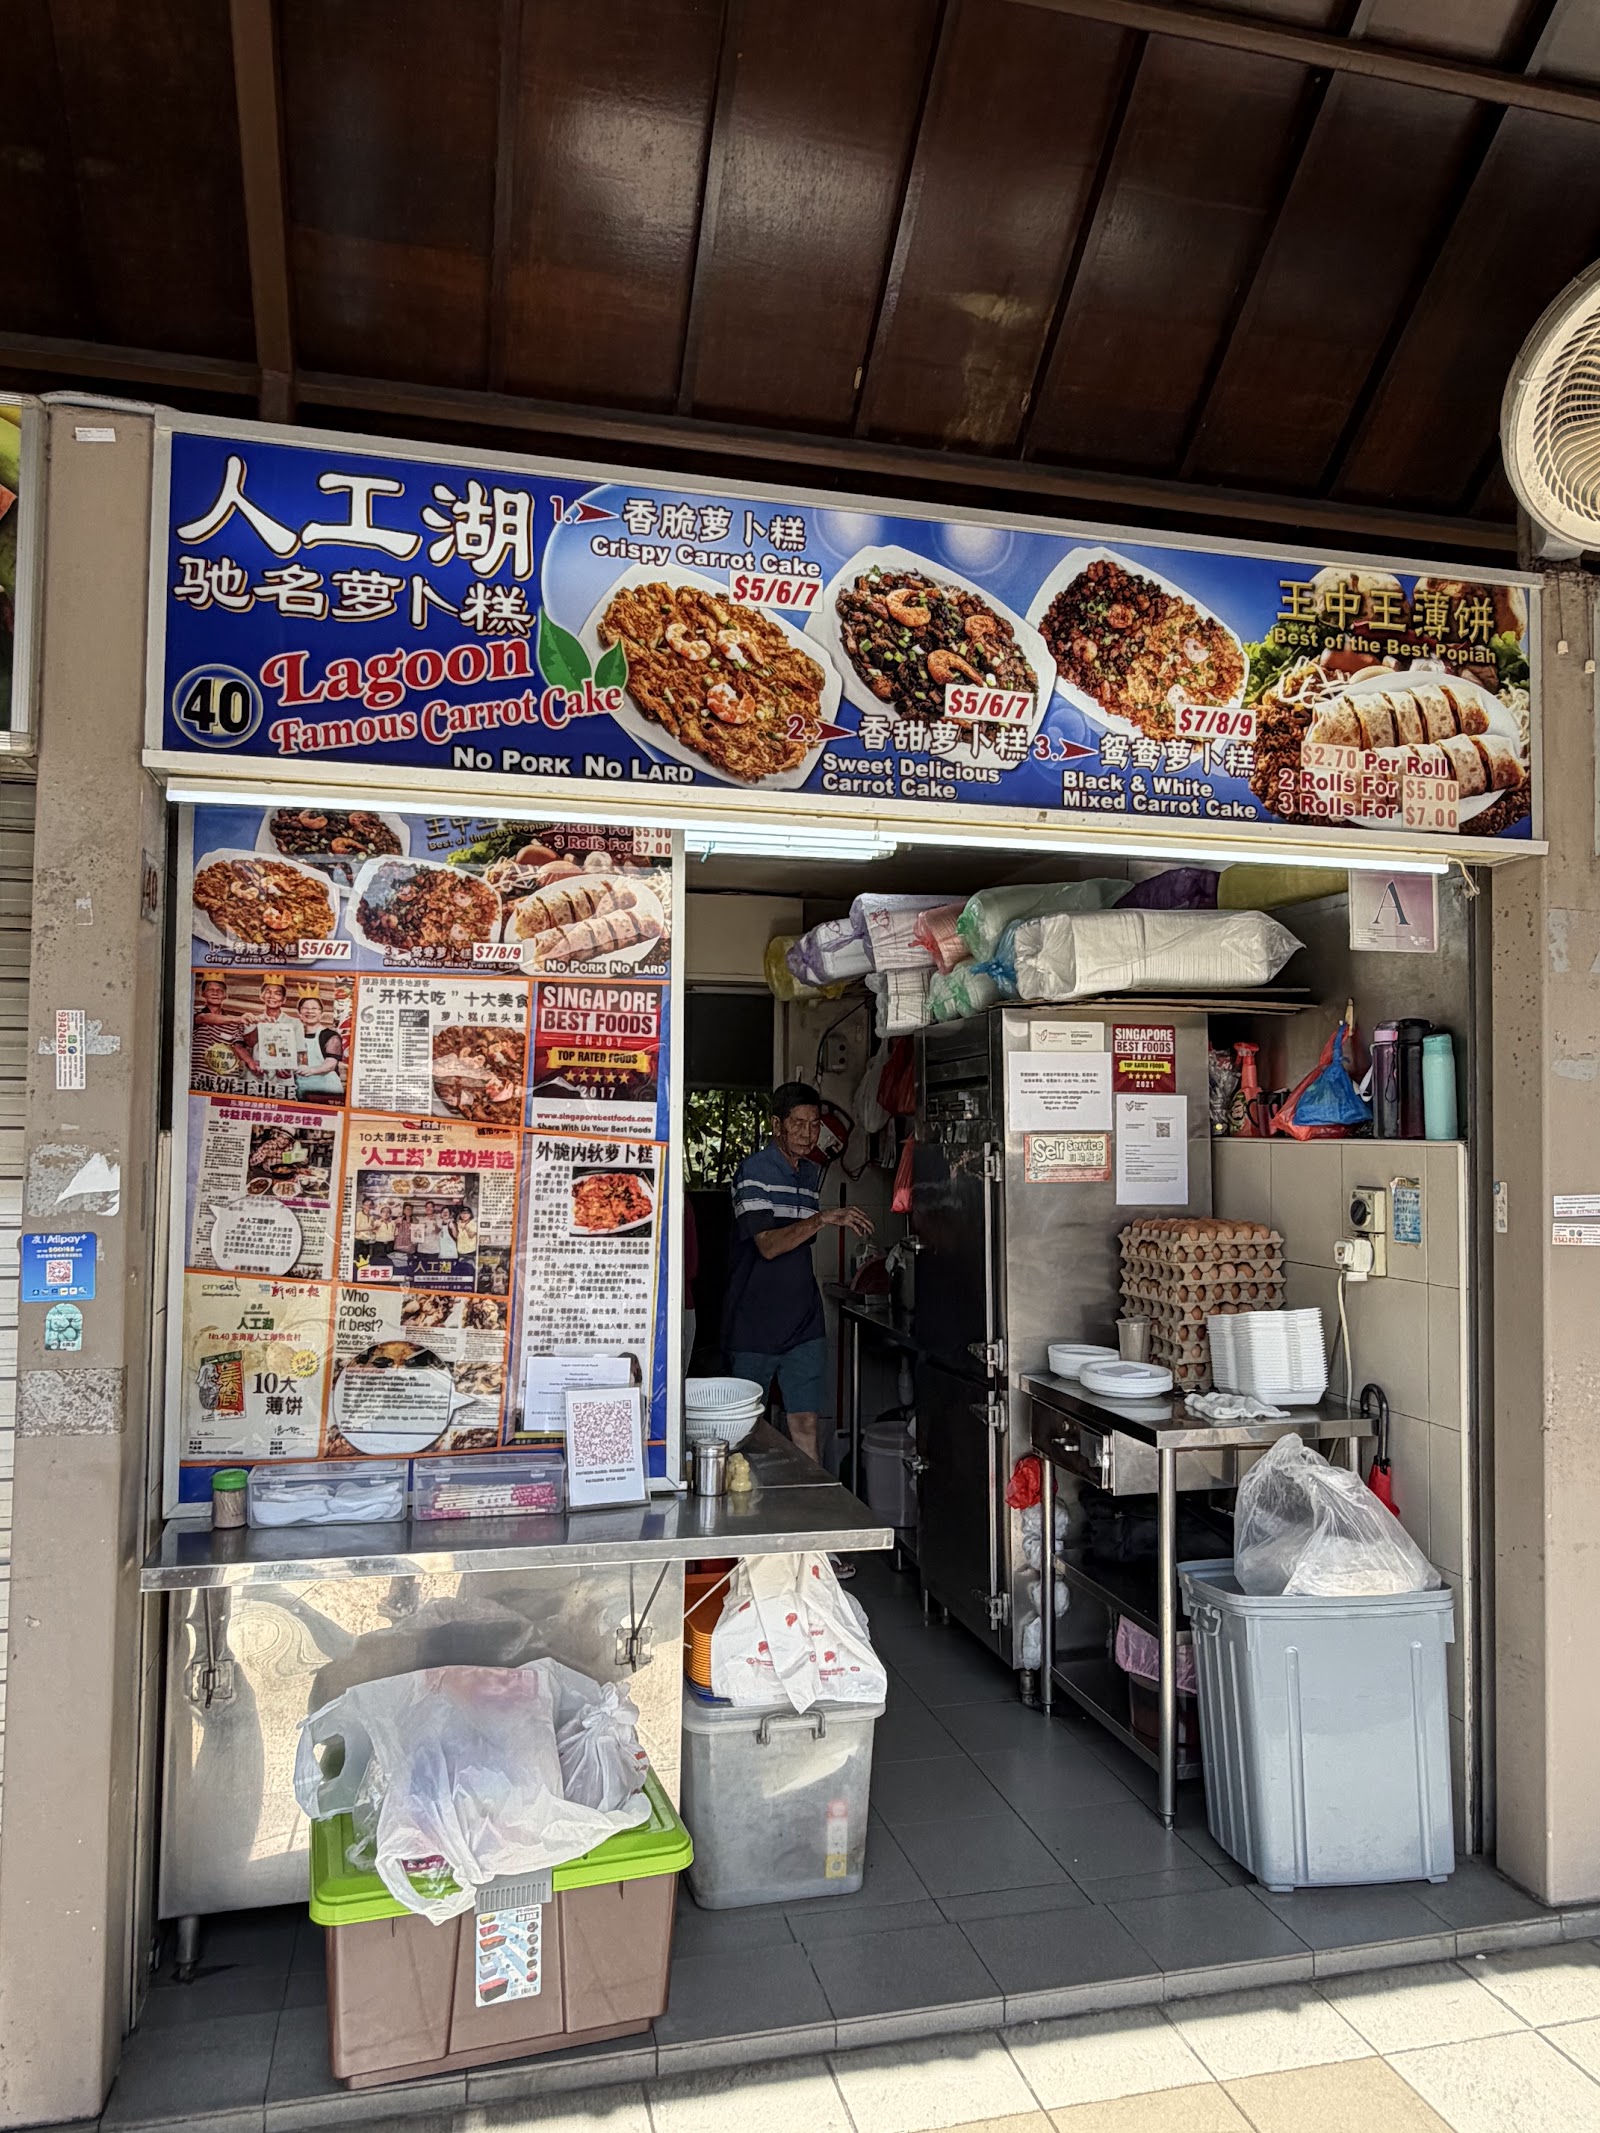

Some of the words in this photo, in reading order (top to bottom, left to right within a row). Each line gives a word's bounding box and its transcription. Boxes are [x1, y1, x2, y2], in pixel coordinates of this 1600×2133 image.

[177, 455, 534, 579] 人工湖
[550, 495, 572, 525] 1.
[623, 498, 807, 552] 香脆萝卜糕
[590, 536, 670, 566] Crispy
[676, 544, 755, 571] Carrot
[761, 554, 821, 577] Cake
[173, 556, 535, 638] 驰名萝卜糕
[733, 574, 820, 607] $5/6/7
[1277, 579, 1494, 644] 王中王薄饼
[1274, 627, 1318, 647] Best
[1324, 633, 1344, 650] of
[1351, 637, 1381, 654] the
[1387, 639, 1429, 658] Best
[1435, 644, 1497, 664] Popiah
[260, 637, 533, 710] Lagoon
[181, 678, 250, 735] 40
[948, 688, 1030, 720] $5/6/7
[268, 710, 416, 757] Famous
[421, 691, 539, 746] Carrot
[540, 678, 625, 731] Cake
[786, 715, 814, 743] 2.
[1178, 707, 1253, 737] $7/8/9
[858, 714, 1029, 761] 香甜萝卜糕
[1034, 734, 1059, 761] 3.
[1100, 732, 1256, 777] 鸳鸯萝卜糕
[1302, 744, 1357, 769] $2.70
[1364, 753, 1399, 773] Per
[1406, 756, 1448, 777] Roll
[822, 753, 894, 776] Sweet
[900, 758, 1001, 783] Delicious
[822, 774, 895, 796] Carrot
[901, 779, 957, 799] Cake
[1062, 770, 1125, 792] Black
[1130, 775, 1146, 793] &
[1152, 776, 1213, 798] White
[1278, 768, 1294, 789] 2
[1300, 770, 1356, 794] Rolls
[1361, 775, 1400, 797] For
[1405, 780, 1458, 803] $5.00
[1062, 789, 1126, 811] Mixed
[1132, 794, 1200, 815] Carrot
[1205, 800, 1258, 820] Cake
[1278, 792, 1294, 814] 3
[1300, 795, 1356, 818] Rolls
[1361, 799, 1400, 820] For
[1405, 805, 1458, 829] $7.00
[554, 836, 565, 849] 3
[567, 836, 604, 850] Rolls
[608, 838, 633, 851] For
[635, 841, 672, 855] $7.00
[635, 827, 672, 839] $5.00
[1370, 880, 1412, 926] A
[204, 955, 231, 965] Crispy
[233, 956, 262, 964] Carrot
[264, 956, 286, 965] Cake
[300, 943, 350, 956] $5/6/7
[475, 944, 522, 960] $7/8/9
[382, 958, 407, 967] Black
[417, 958, 442, 968] White
[444, 960, 469, 969] Mixed
[471, 961, 497, 970] Carrot
[543, 986, 657, 1013] SINGAPORE
[57, 1012, 67, 1055] 93424528
[544, 1010, 590, 1032] BEST
[595, 1014, 653, 1035] FOODS
[1115, 1028, 1173, 1041] SINGAPORE
[575, 1036, 623, 1047] ENJOY
[1116, 1042, 1140, 1052] BEST
[1142, 1042, 1171, 1053] FOODS
[557, 1050, 574, 1060] TOP
[577, 1051, 606, 1062] RATED
[608, 1053, 638, 1064] FOODS
[581, 1086, 615, 1098] 2017
[537, 1112, 653, 1123] www.singaporebestfoods.com
[538, 1123, 560, 1131] Share
[561, 1123, 578, 1132] With
[581, 1124, 590, 1132] Us
[592, 1124, 608, 1133] Your
[611, 1125, 627, 1133] Best
[629, 1125, 652, 1134] Foods
[360, 1132, 444, 1143] 10大薄饼王中王
[535, 1141, 653, 1164] 外脆内软萝卜糕
[1034, 1139, 1065, 1163] Self
[1067, 1140, 1103, 1151] Service
[47, 1234, 87, 1245] Alipay+
[360, 1269, 390, 1279] 王中王
[341, 1288, 369, 1302] Who
[237, 1317, 274, 1330] 人工湖
[339, 1305, 376, 1317] cooks
[337, 1332, 350, 1340] We
[338, 1319, 346, 1331] it
[349, 1320, 383, 1333] best?
[253, 1373, 297, 1394] 10大
[265, 1396, 303, 1416] 薄饼
